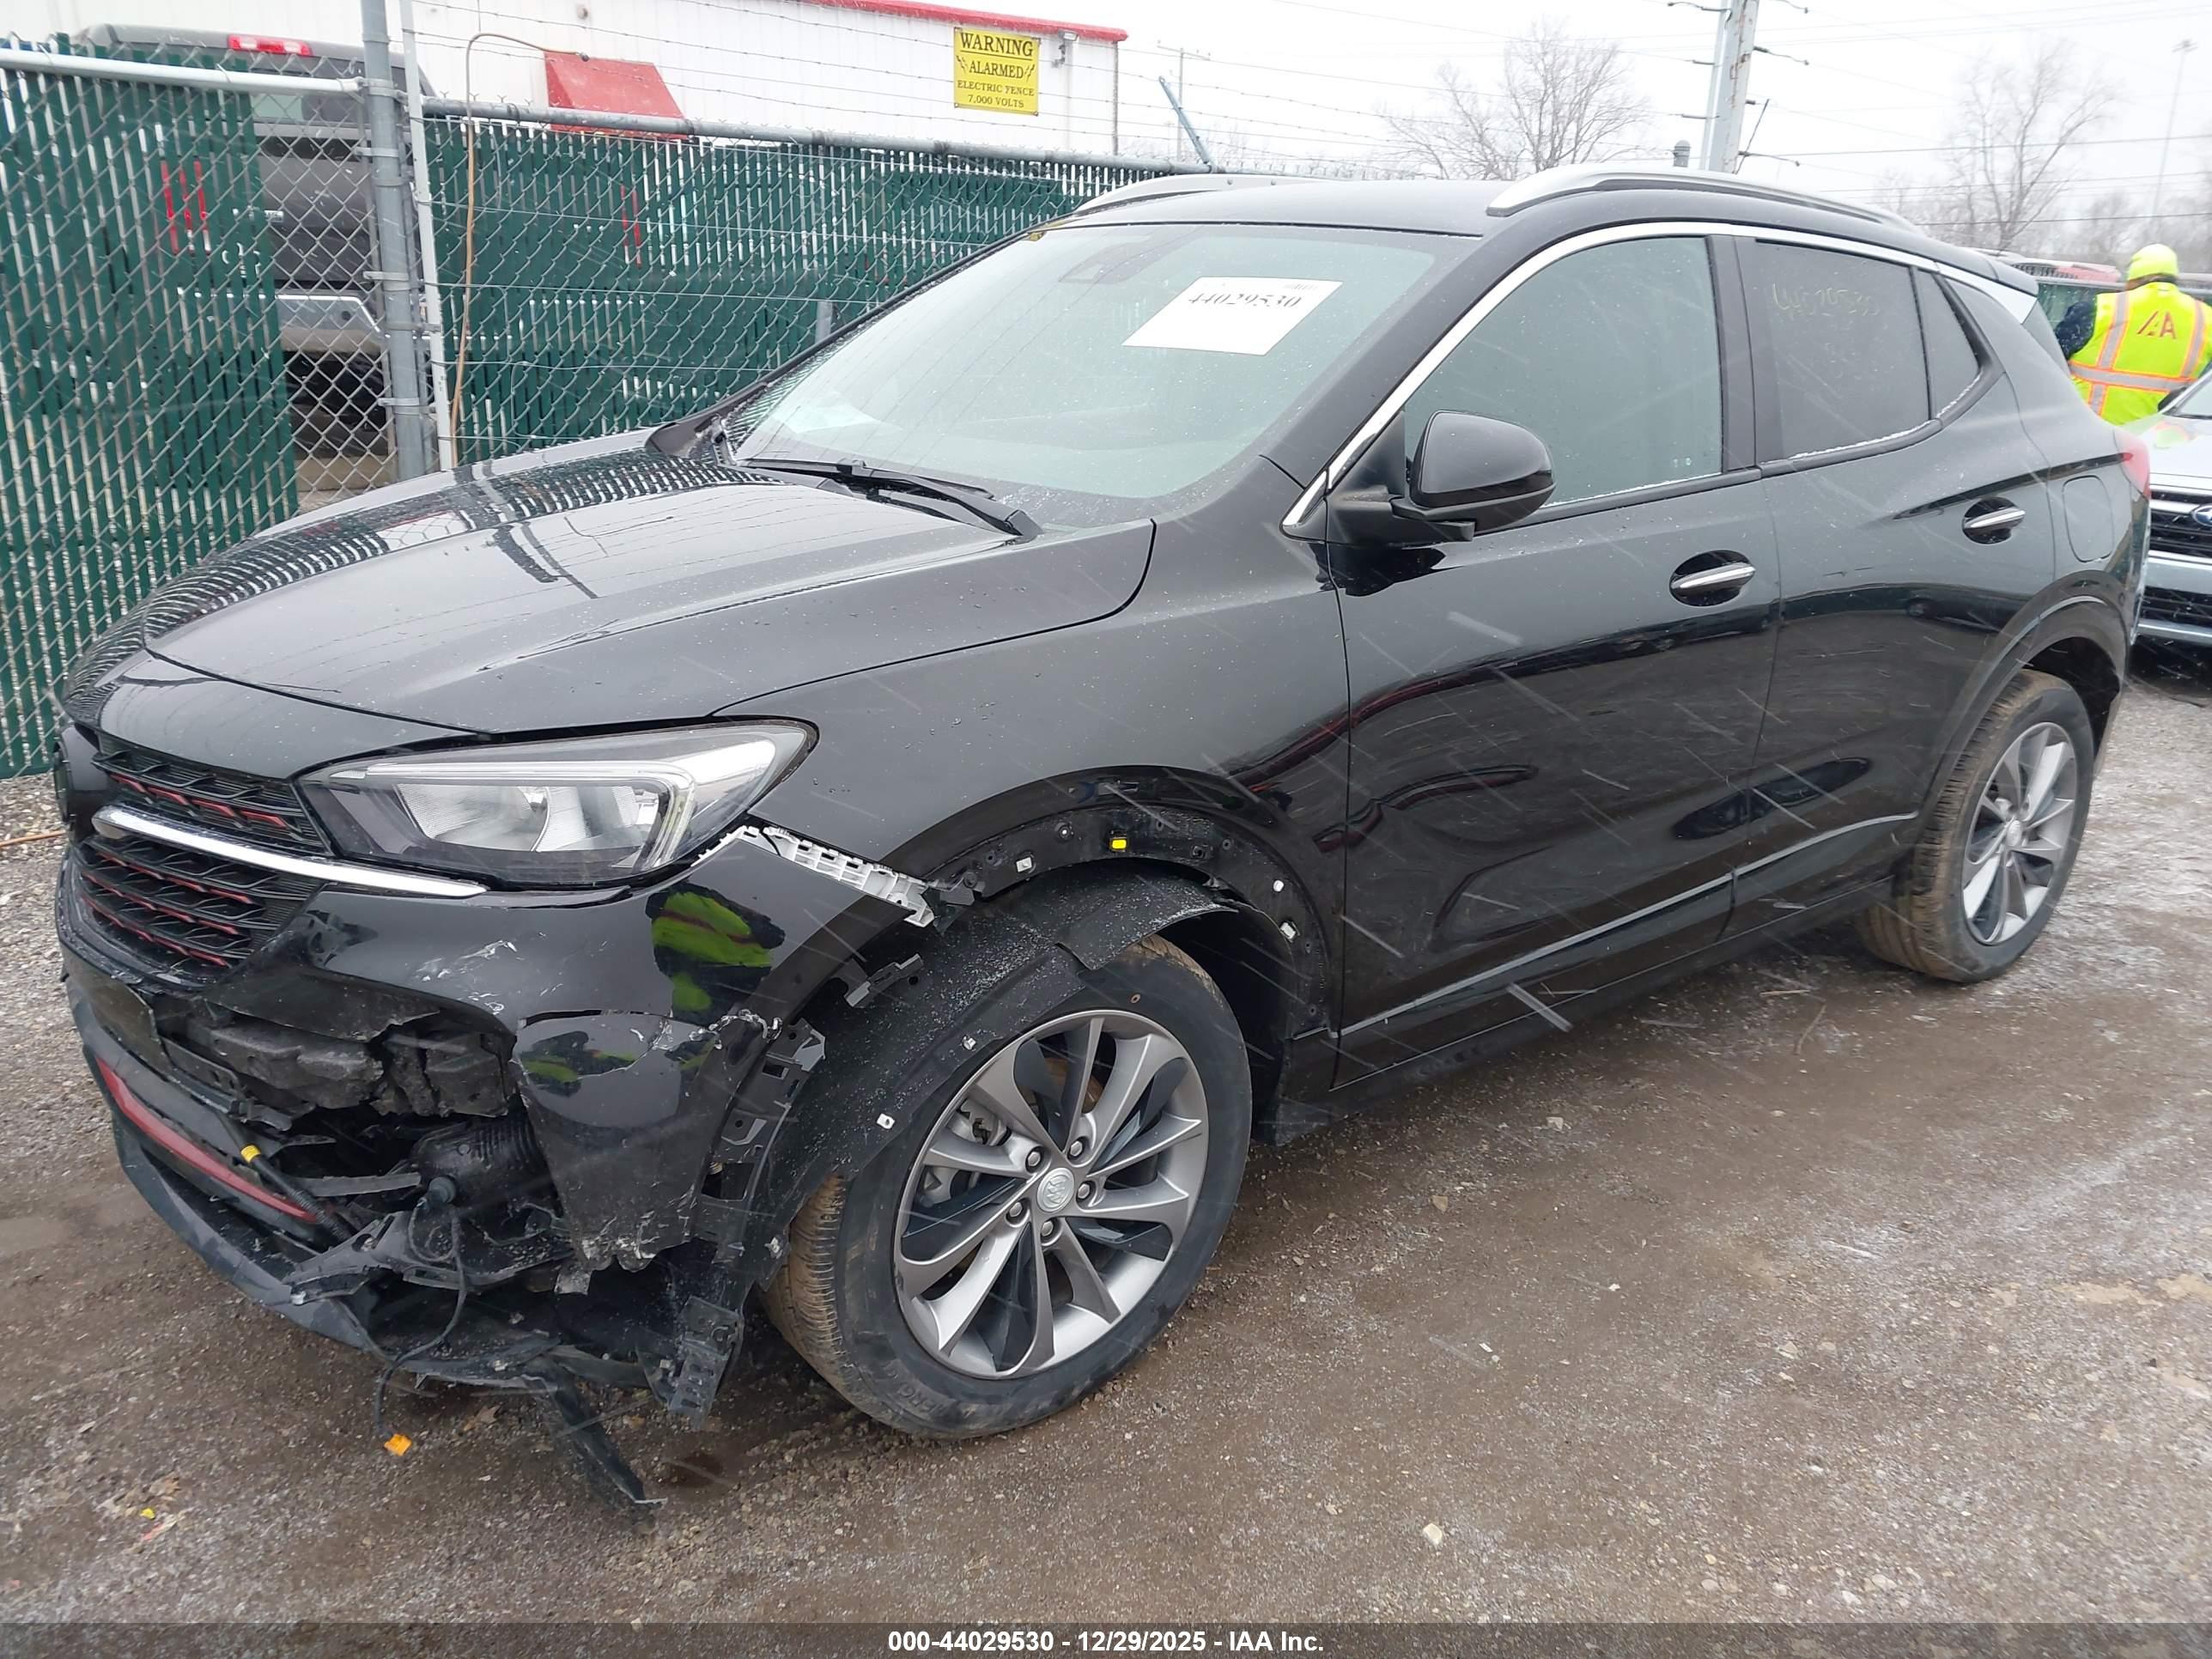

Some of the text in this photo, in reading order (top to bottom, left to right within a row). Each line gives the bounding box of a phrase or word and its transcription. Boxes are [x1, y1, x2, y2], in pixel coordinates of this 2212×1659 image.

[960, 33, 1033, 57] WARNING
[969, 60, 1024, 79] ALARMED
[957, 80, 1035, 96] ELECTRIC FENCE
[995, 97, 1024, 108] VOLTS
[1188, 293, 1303, 307] 44029530
